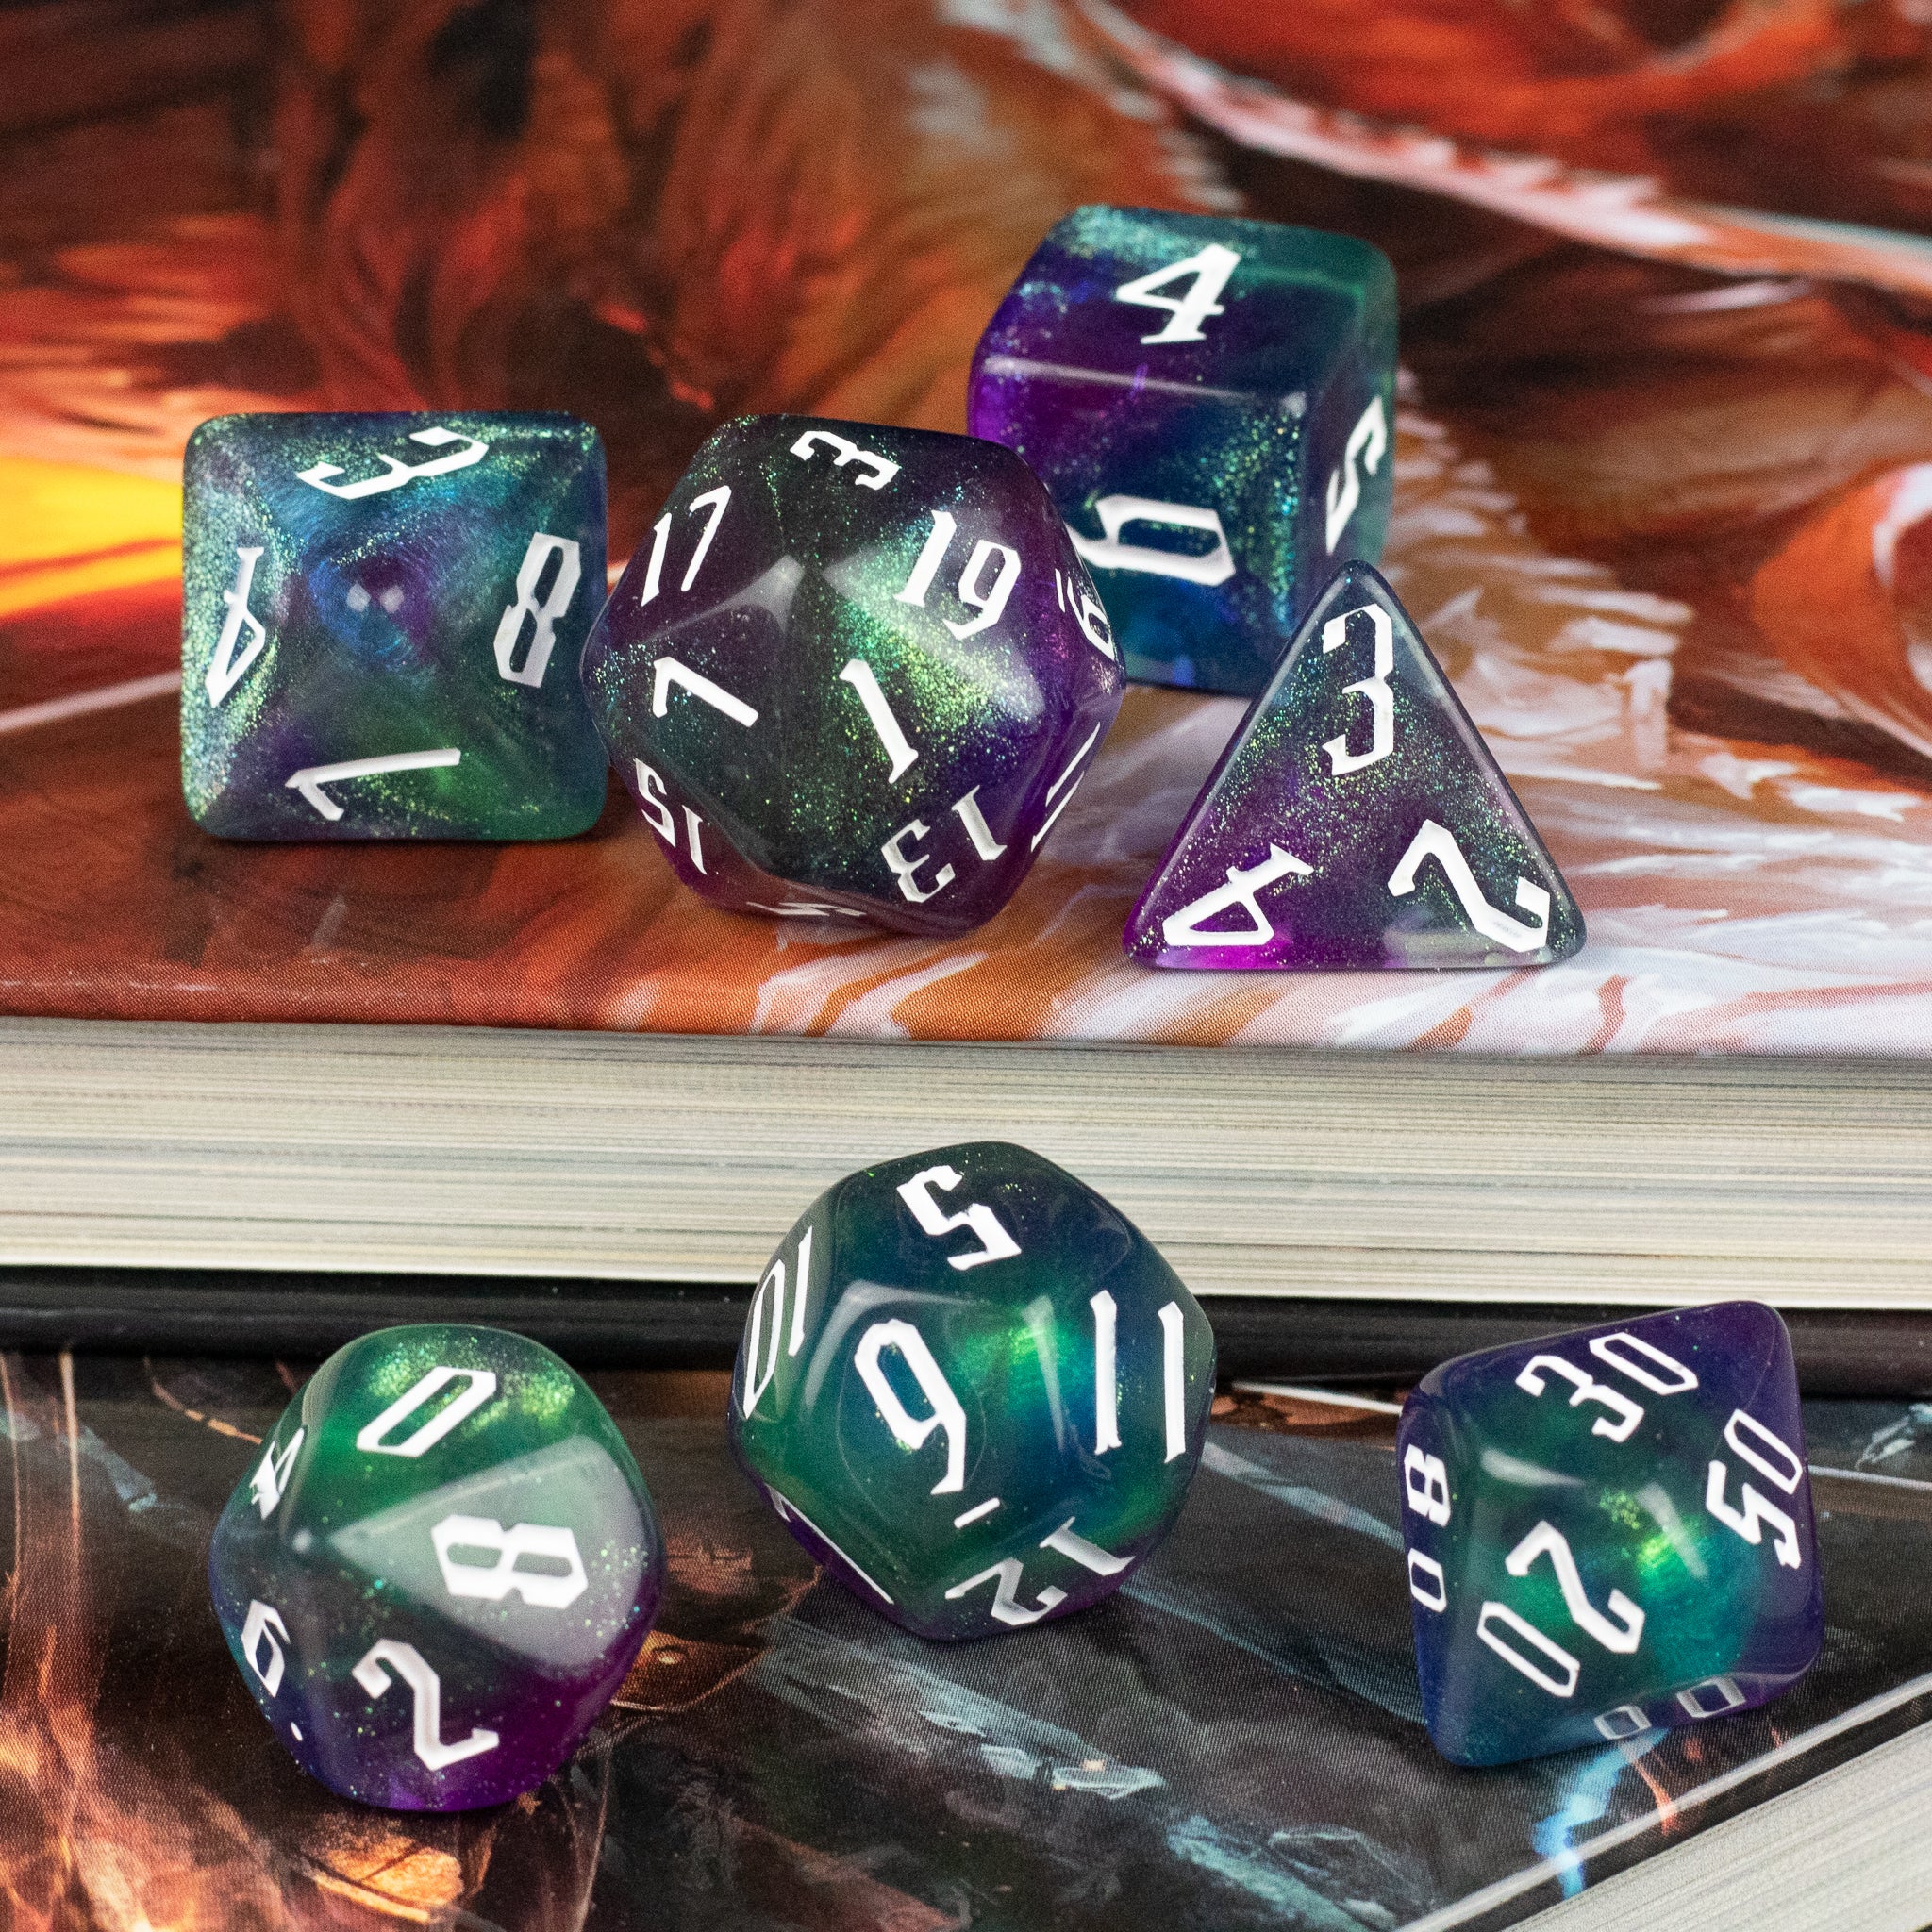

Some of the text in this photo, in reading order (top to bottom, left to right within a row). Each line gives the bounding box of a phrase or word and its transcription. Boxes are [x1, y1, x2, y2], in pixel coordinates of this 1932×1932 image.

[1116, 243, 1241, 345] 4
[295, 426, 490, 500] 3
[790, 430, 901, 491] 3
[641, 485, 731, 607] 17
[894, 509, 1022, 641] 19
[205, 546, 267, 708] 4
[492, 531, 582, 689] 8
[652, 656, 758, 727] 7
[839, 658, 919, 784] 1
[1322, 603, 1394, 776] 3
[880, 785, 1008, 903] 13
[1162, 842, 1314, 947] 4
[1387, 818, 1551, 953] 2
[896, 1164, 1023, 1271] 5
[741, 1225, 813, 1420] 10
[1089, 1289, 1187, 1464] 11
[356, 1366, 497, 1457] 0
[853, 1318, 967, 1496] 9
[1515, 1331, 1699, 1443] 30
[1404, 1443, 1452, 1613] 80
[1706, 1408, 1804, 1570] 50
[430, 1514, 589, 1609] 8
[945, 1516, 1136, 1626] 12
[1476, 1520, 1646, 1699] 20
[351, 1638, 500, 1771] 2
